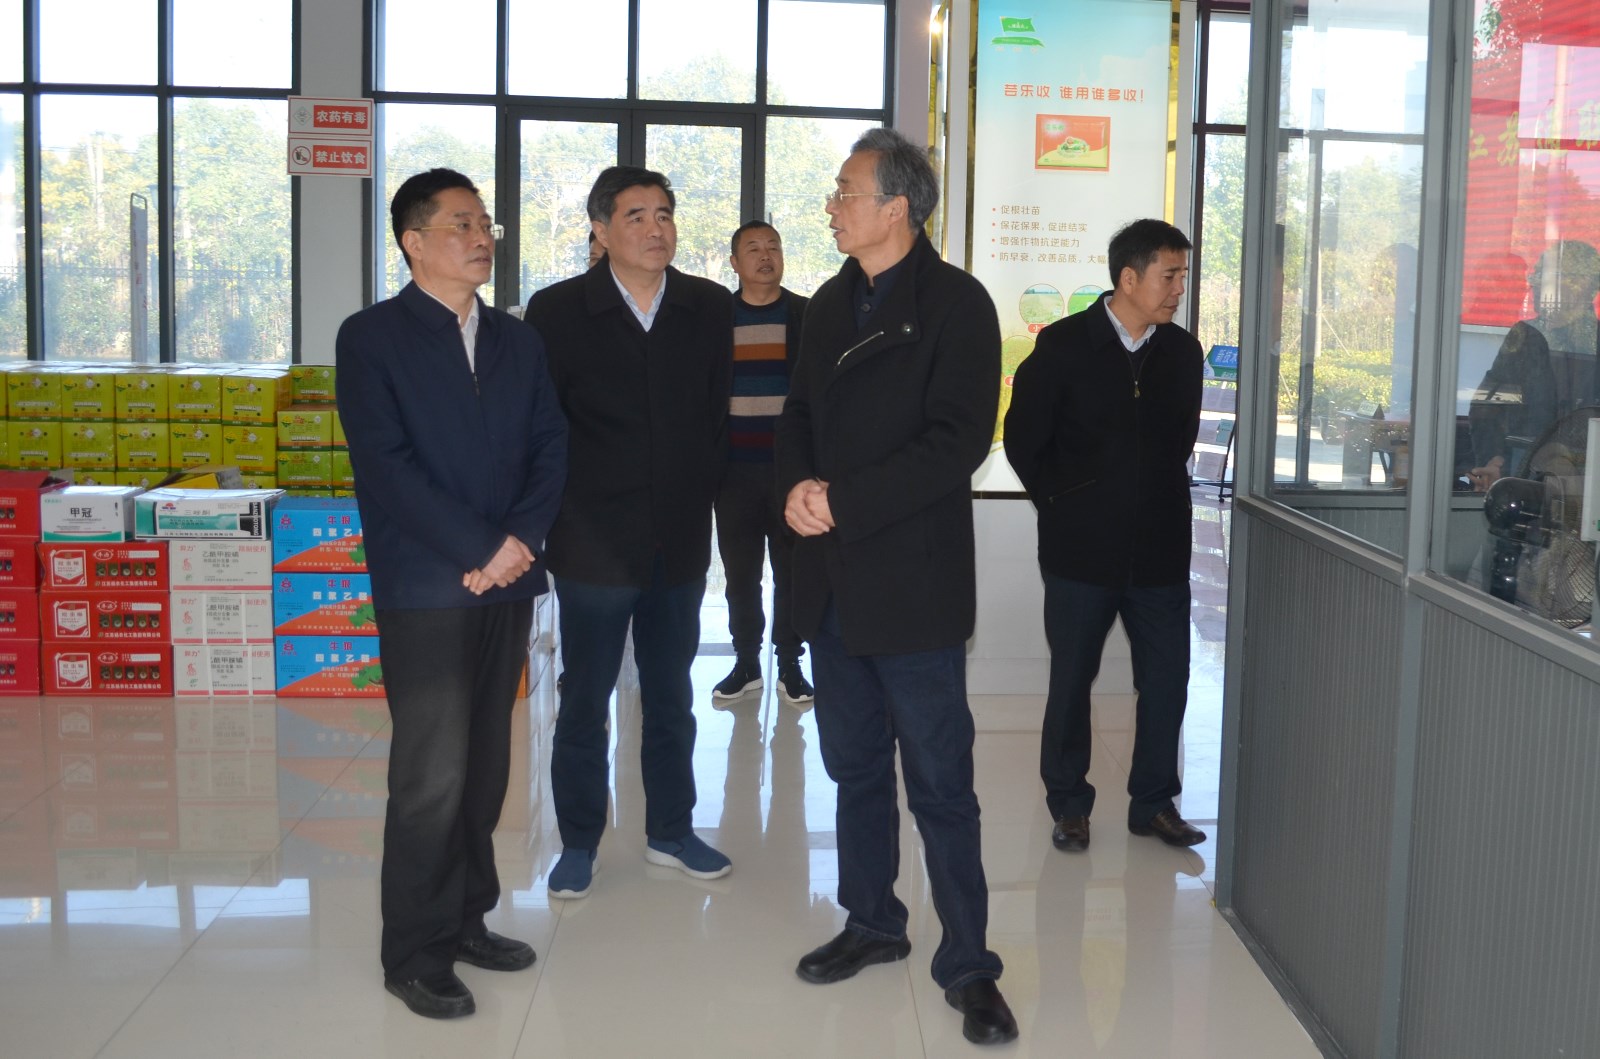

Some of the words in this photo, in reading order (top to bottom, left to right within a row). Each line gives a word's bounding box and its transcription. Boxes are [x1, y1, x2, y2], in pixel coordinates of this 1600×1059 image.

[316, 110, 367, 124] 农药有毒
[315, 151, 366, 164] 禁止饮食
[1001, 205, 1040, 216] 促根壮苗
[1000, 237, 1080, 248] 增强作物抗逆能力
[70, 507, 92, 518] 甲冠
